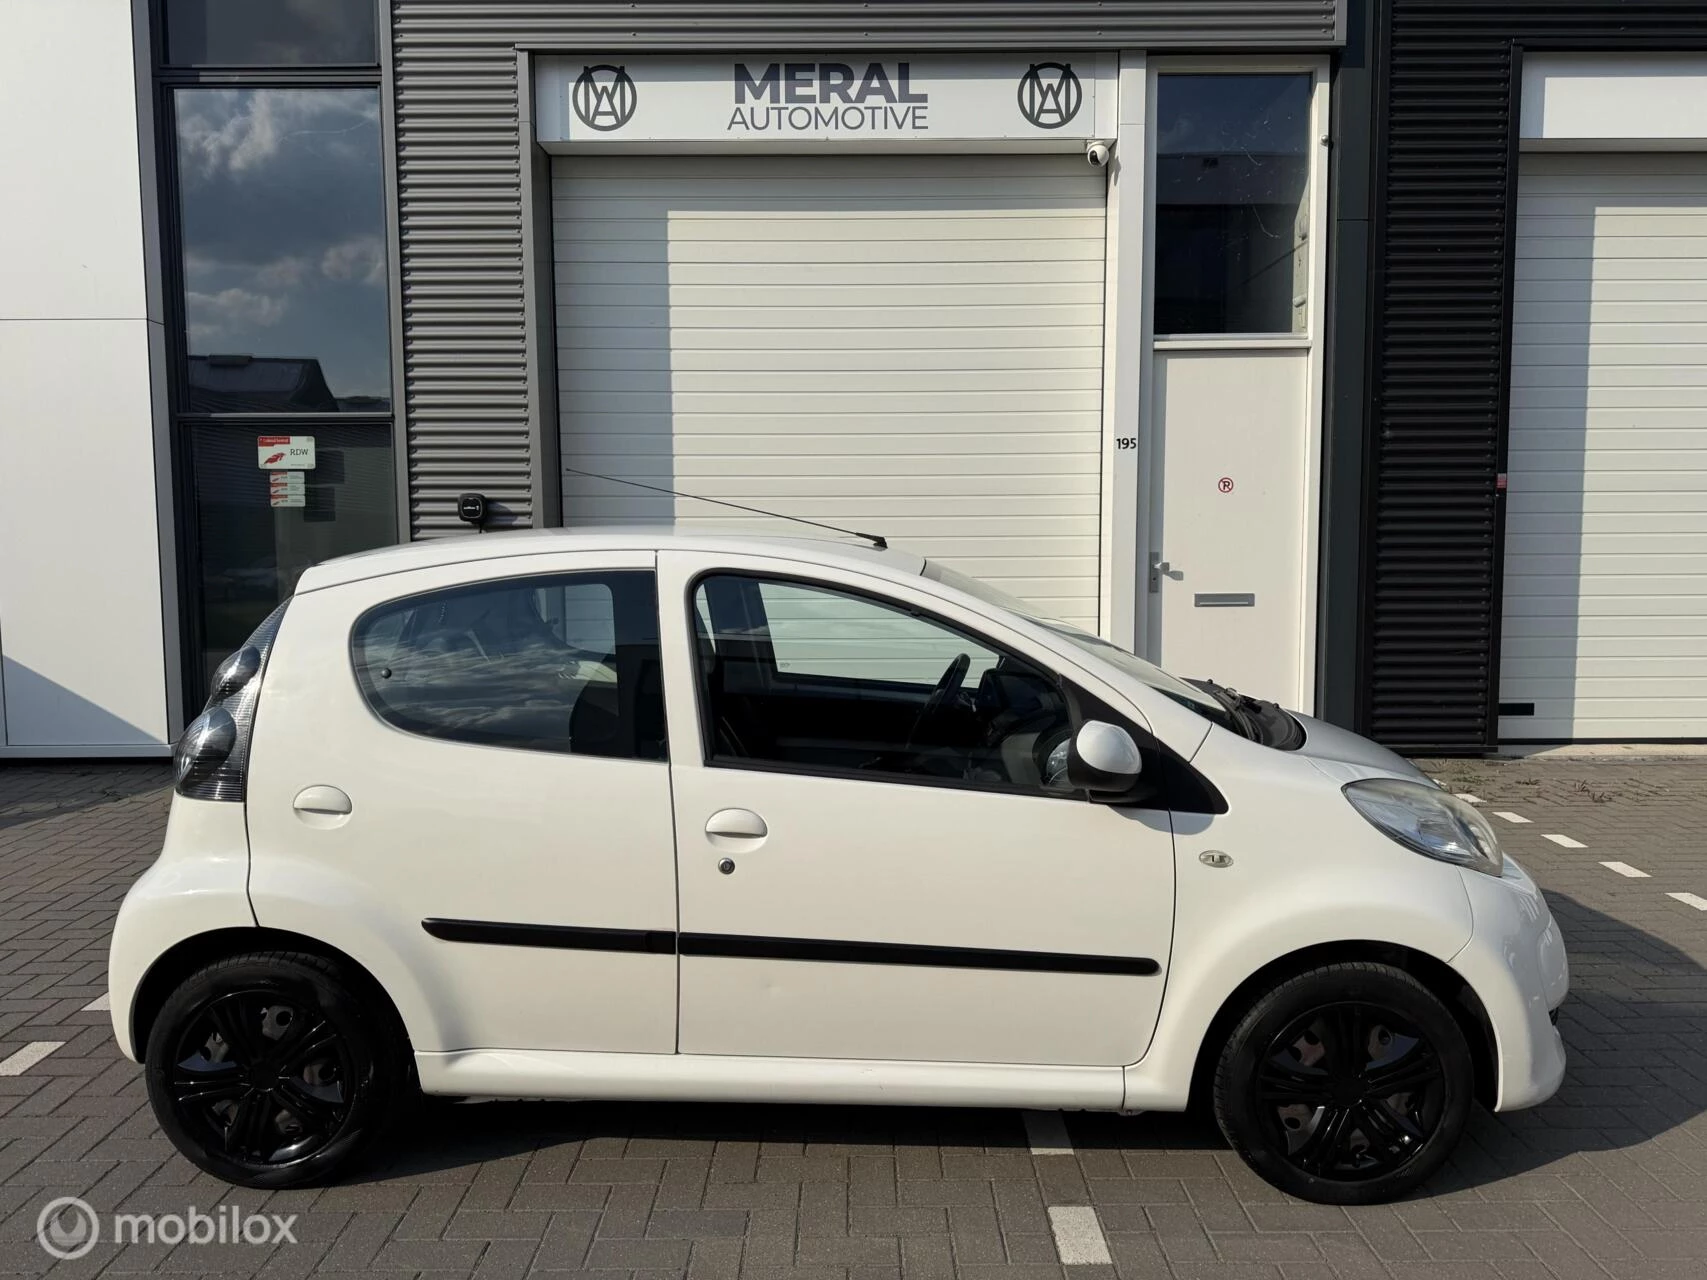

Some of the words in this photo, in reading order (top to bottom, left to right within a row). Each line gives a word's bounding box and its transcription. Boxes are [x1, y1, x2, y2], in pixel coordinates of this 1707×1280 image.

[734, 63, 929, 104] MERAL
[727, 106, 929, 131] AUTOMOTIVE
[289, 448, 309, 456] RDW
[1116, 437, 1137, 450] 195
